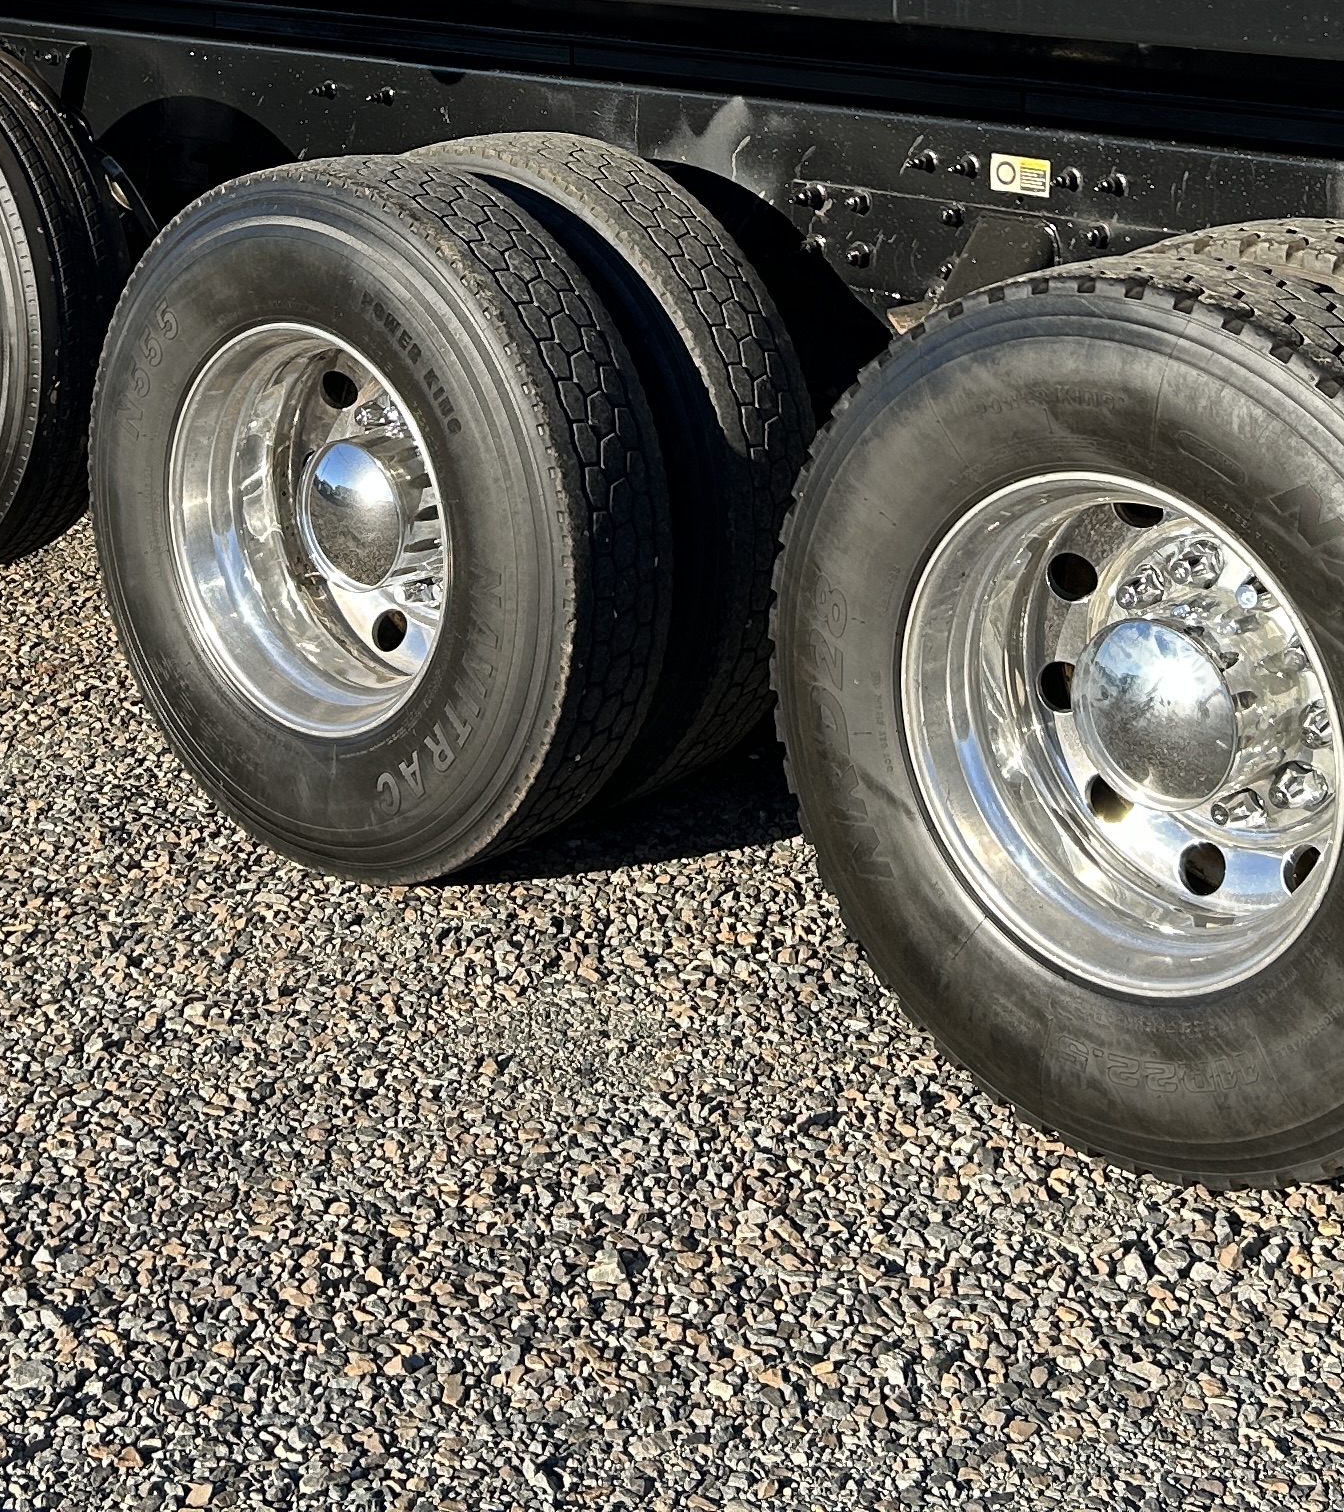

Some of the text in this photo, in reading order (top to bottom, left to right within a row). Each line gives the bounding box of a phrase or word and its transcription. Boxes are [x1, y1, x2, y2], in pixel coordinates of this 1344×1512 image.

[116, 298, 182, 440] N555
[360, 289, 462, 434] POWER KING
[375, 565, 503, 816] NAVITRAC
